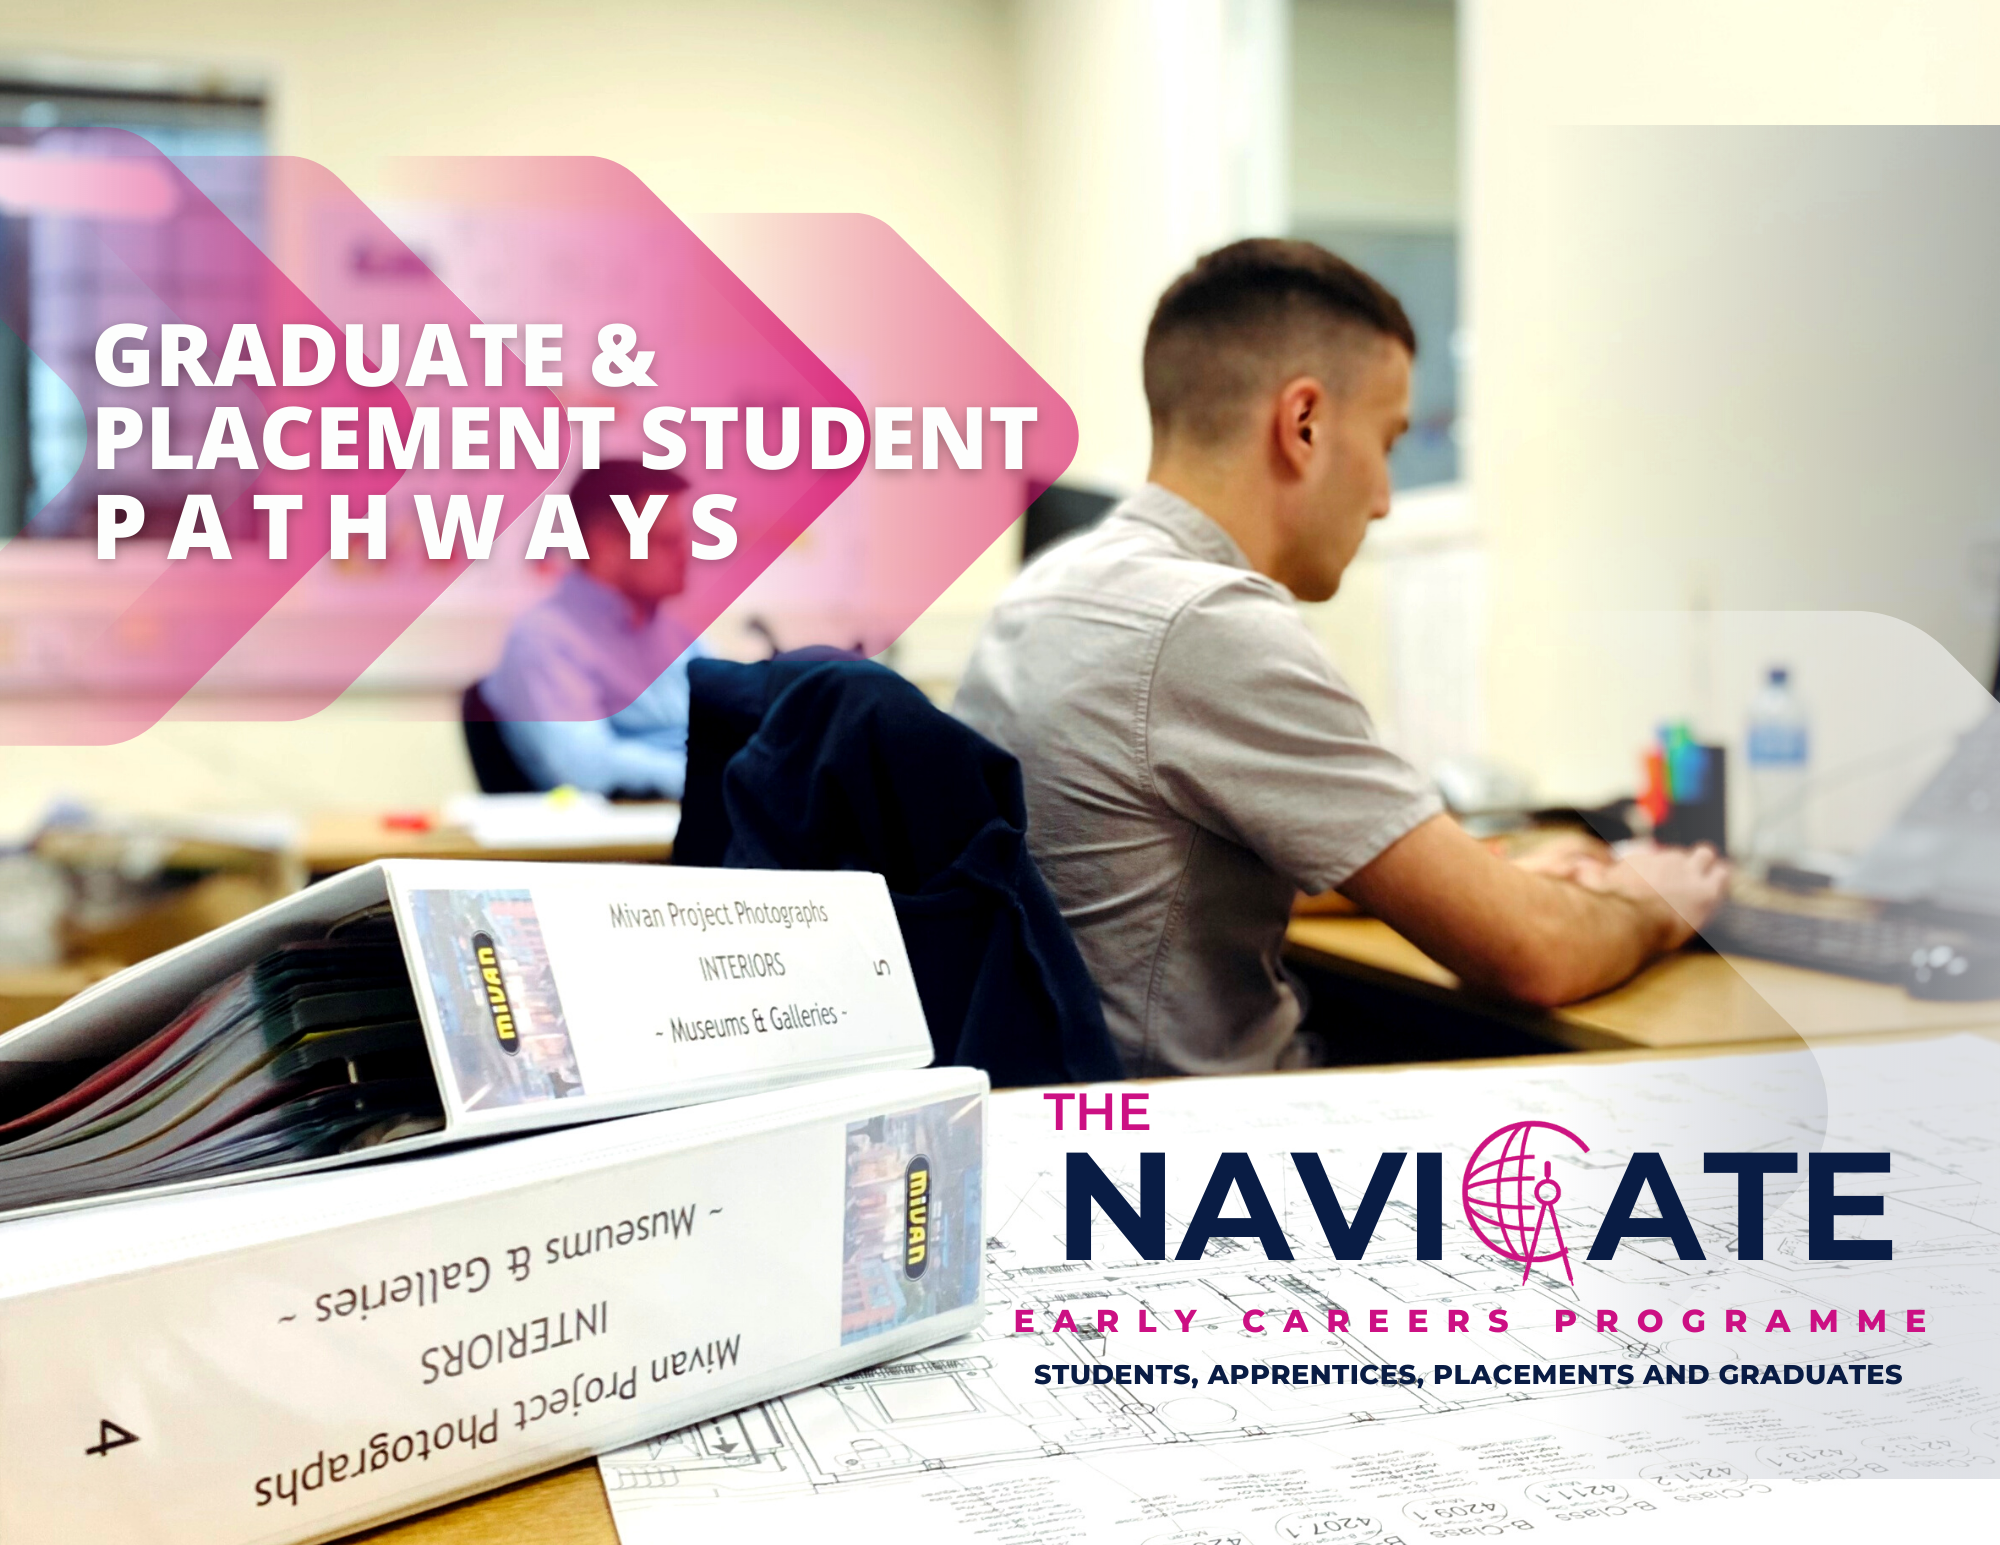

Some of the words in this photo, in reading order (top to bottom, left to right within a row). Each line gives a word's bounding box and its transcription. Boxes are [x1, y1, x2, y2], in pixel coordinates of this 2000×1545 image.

[610, 903, 665, 928] Mivan
[667, 902, 733, 931] Project
[734, 900, 828, 928] Photographs
[699, 952, 786, 981] INTERIORS
[873, 959, 891, 976] 5
[670, 1014, 750, 1043] Museums
[752, 1008, 767, 1033] &
[769, 1002, 838, 1031] Galleries
[546, 1204, 696, 1264] Museums
[507, 1246, 531, 1281] &
[315, 1257, 491, 1320] Galleries
[421, 1301, 608, 1385] INTERIORS
[650, 1334, 742, 1381] Mivan
[514, 1365, 638, 1429] Project
[86, 1418, 140, 1456] 4
[255, 1409, 499, 1507] Photographs
[1792, 1462, 1889, 1484] B-Class
[1536, 1484, 1616, 1504] 4211.1
[1674, 1484, 1772, 1502] C-Class
[1413, 1502, 1496, 1521] 4209.1
[1555, 1501, 1657, 1521] B-Class
[1286, 1517, 1371, 1539] 4207.1
[1430, 1519, 1535, 1538] B-Class
